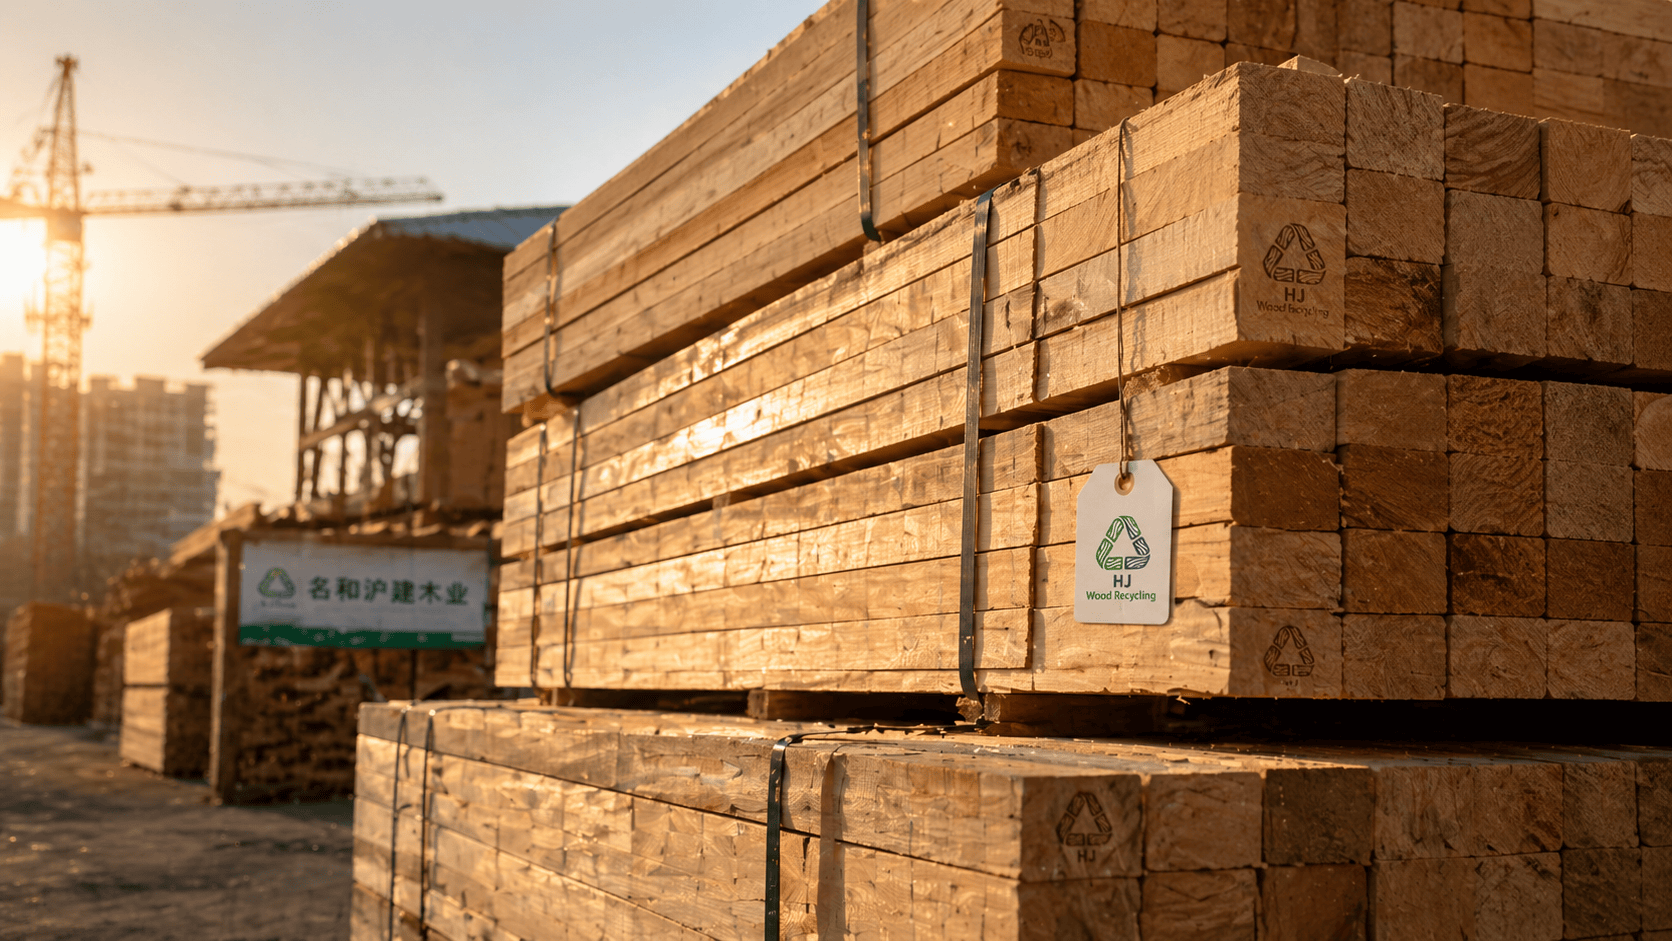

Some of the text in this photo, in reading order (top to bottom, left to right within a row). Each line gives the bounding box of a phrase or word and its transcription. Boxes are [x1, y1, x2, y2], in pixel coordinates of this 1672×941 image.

[1284, 287, 1305, 303] HJ
[1113, 574, 1131, 588] HJ
[308, 575, 468, 605] 名和沪建木业
[1086, 590, 1156, 602] Wood Recycling
[1077, 849, 1096, 862] HJ
